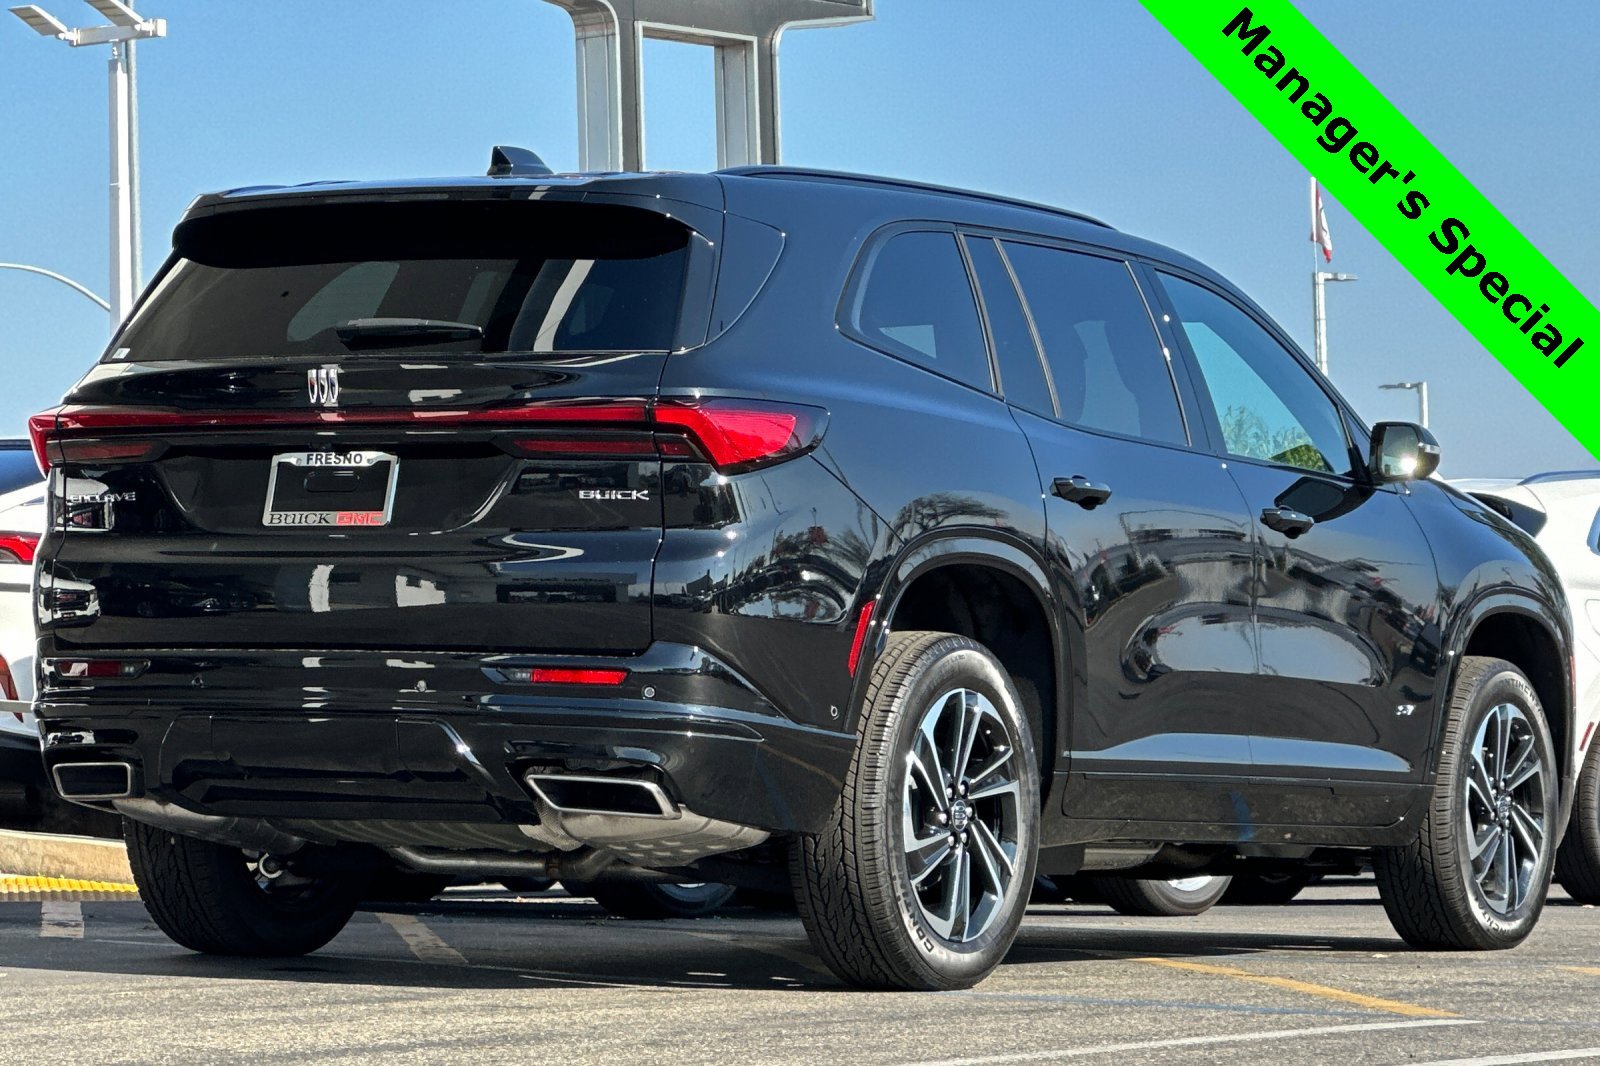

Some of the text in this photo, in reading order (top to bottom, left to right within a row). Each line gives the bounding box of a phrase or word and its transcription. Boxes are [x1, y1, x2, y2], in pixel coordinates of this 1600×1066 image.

[306, 452, 363, 465] FRESNO
[578, 489, 650, 501] BUICK
[268, 511, 383, 525] BUICK GMC
